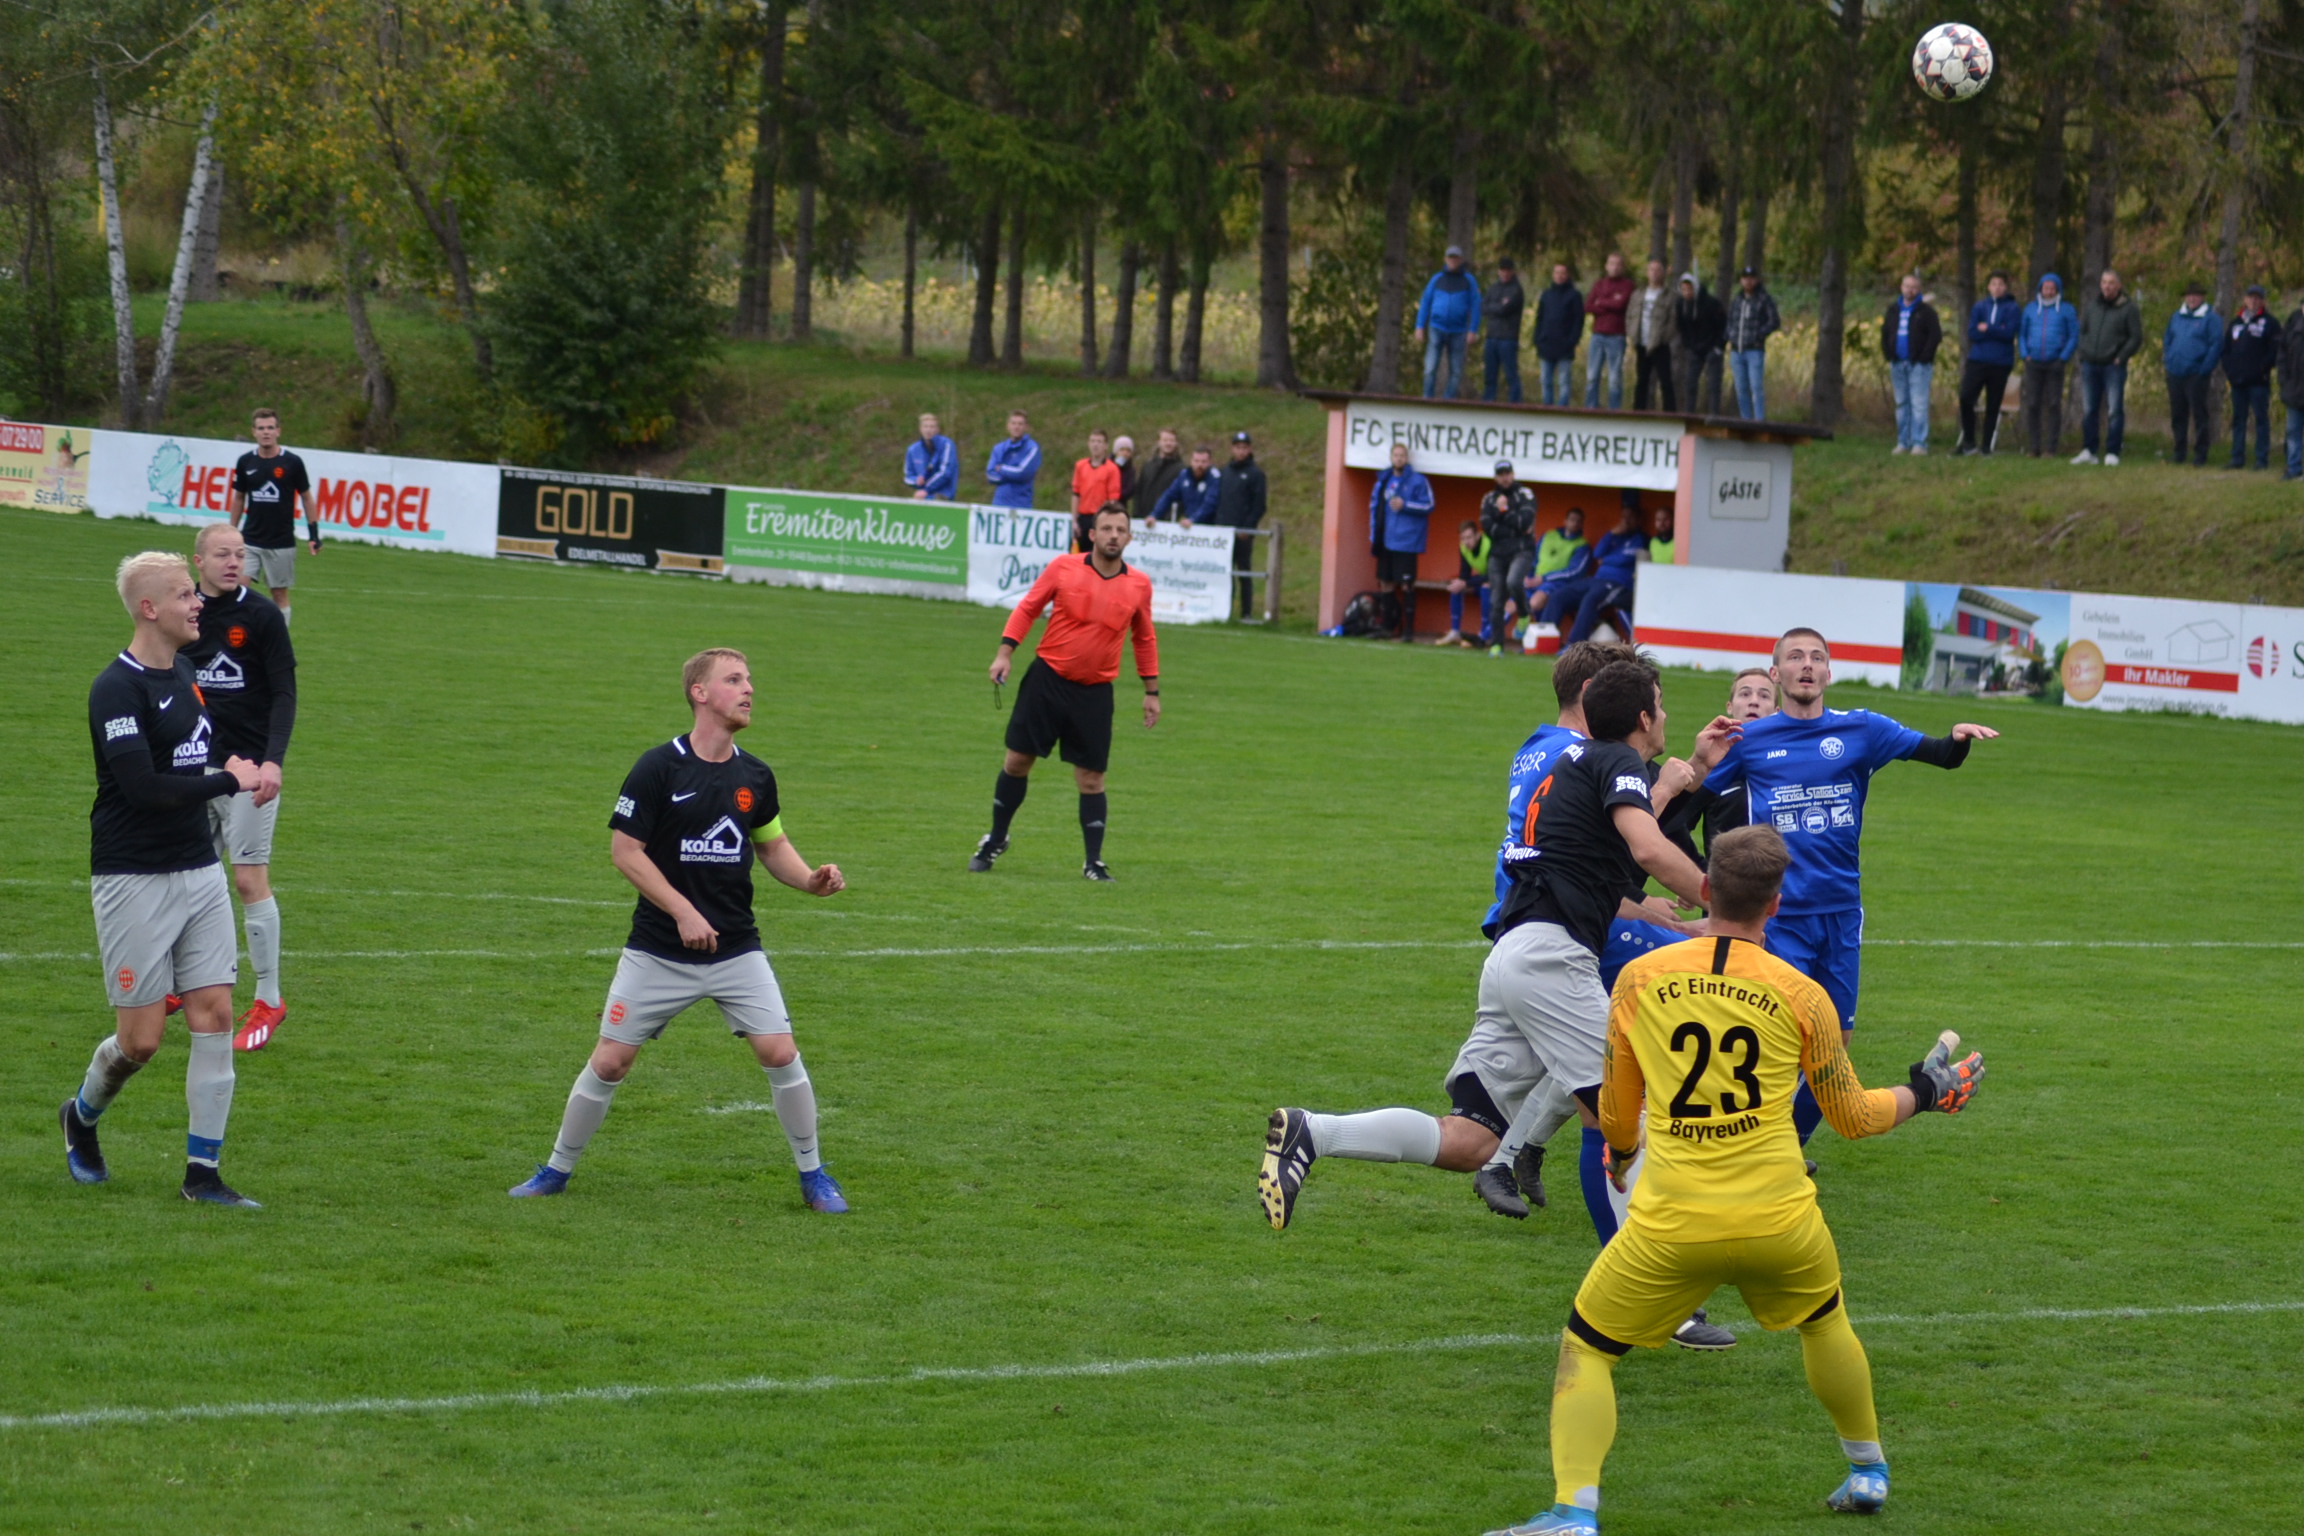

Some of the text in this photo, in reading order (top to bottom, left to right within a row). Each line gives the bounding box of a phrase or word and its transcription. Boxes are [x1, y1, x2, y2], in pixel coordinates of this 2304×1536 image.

[1351, 418, 1678, 468] FC EINTRACHT BAYREUTH
[536, 485, 633, 540] GOLD
[746, 502, 956, 551] Eremitenklause
[567, 546, 647, 566] EDELMETALLHANDEL
[2124, 667, 2190, 687] Ihr Makler
[105, 716, 137, 733] SC24
[173, 741, 208, 758] KOLB
[1766, 749, 1787, 760] JAKO
[1525, 774, 1554, 846] 6
[1775, 813, 1795, 826] SB
[681, 839, 725, 854] KOLB
[680, 854, 742, 863] BEDACHUNGEN
[1657, 978, 1779, 1017] FC Eintracht
[1669, 1021, 1763, 1119] 23
[1670, 1114, 1761, 1144] Bayreuth
